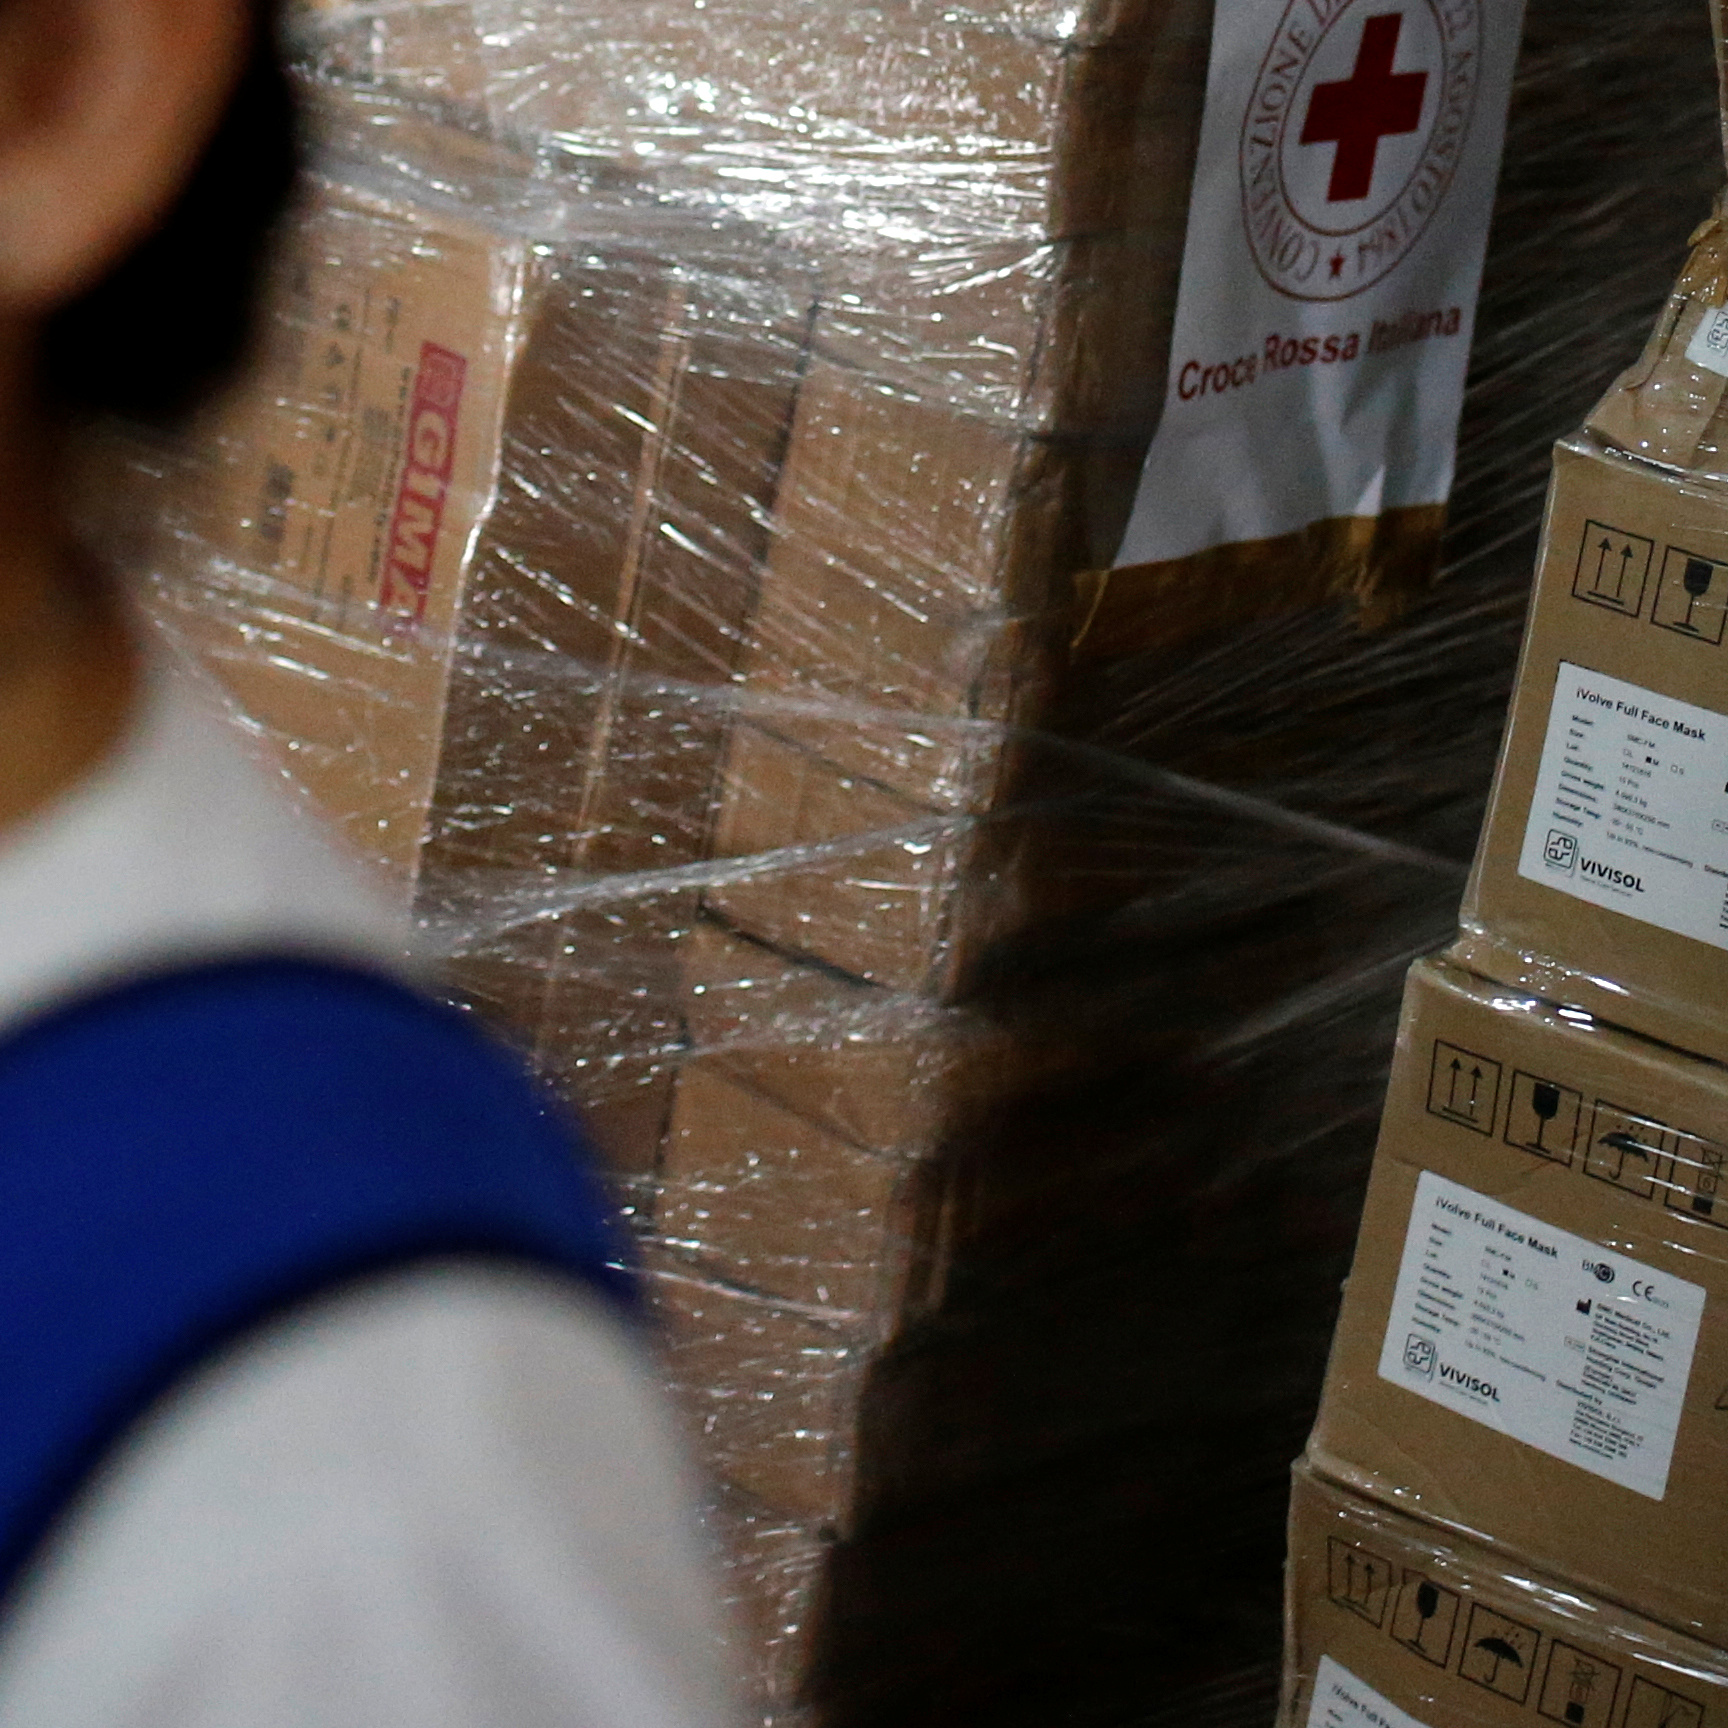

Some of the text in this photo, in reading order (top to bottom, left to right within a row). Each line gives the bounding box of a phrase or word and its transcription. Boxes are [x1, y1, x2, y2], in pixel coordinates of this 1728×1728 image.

[1177, 354, 1257, 402] Croce
[1262, 332, 1360, 375] Rossa
[1576, 686, 1706, 741] iVolve Full Face Mask
[1580, 856, 1646, 894] VIVISOL
[1474, 1212, 1496, 1231] Full
[1497, 1222, 1525, 1245] Face
[1527, 1236, 1559, 1260] Mask
[1438, 1361, 1502, 1404] VIVISOL
